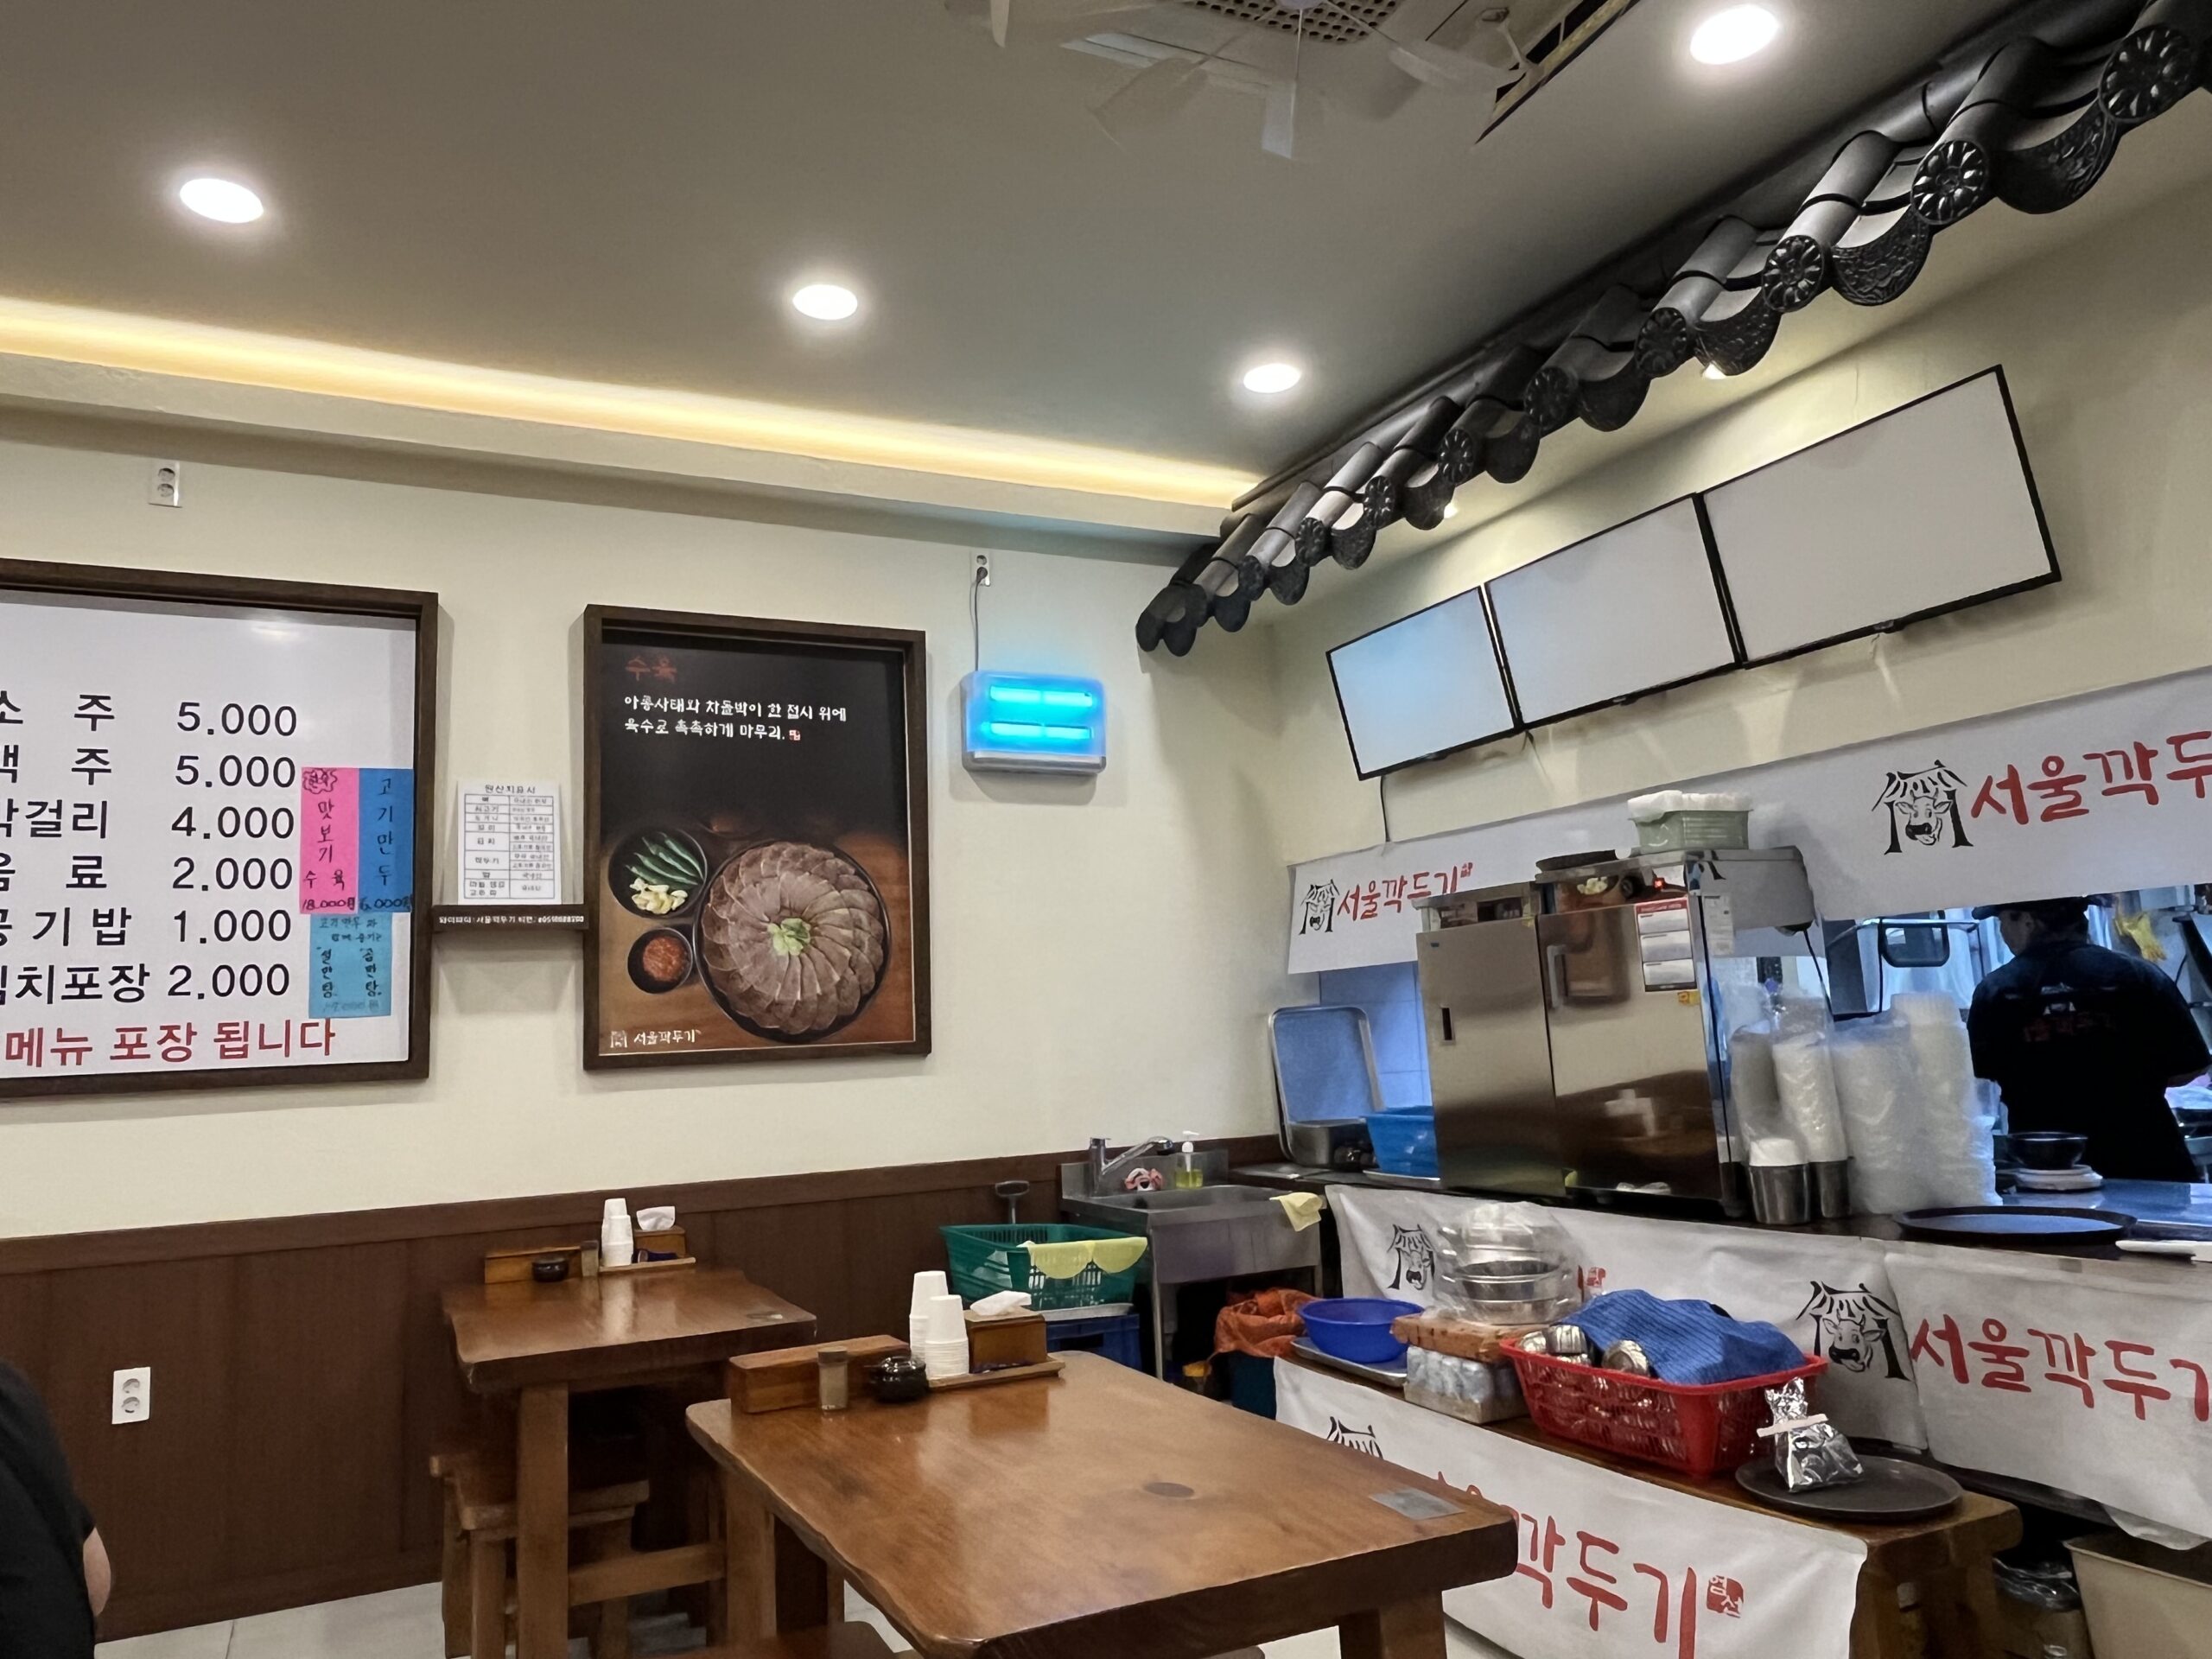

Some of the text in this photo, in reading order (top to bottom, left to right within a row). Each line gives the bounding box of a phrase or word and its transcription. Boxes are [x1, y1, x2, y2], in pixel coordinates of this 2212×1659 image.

[625, 655, 678, 683] 수육
[177, 702, 296, 736] 5.000
[624, 695, 847, 722] 아롱사태와 차돌박이 한 접시 위에
[624, 717, 669, 734] 육수로
[675, 719, 734, 738] 촉촉하게
[740, 723, 785, 741] 마무리.
[175, 754, 296, 788] 5.000
[1971, 731, 2212, 824] 서울깍두
[171, 806, 295, 840] 4.000
[172, 856, 293, 892] 2.000
[174, 909, 291, 944] 1.000
[0, 963, 289, 1006] 치포장 2.000
[5, 1019, 337, 1067] 메뉴 포장 됩니다
